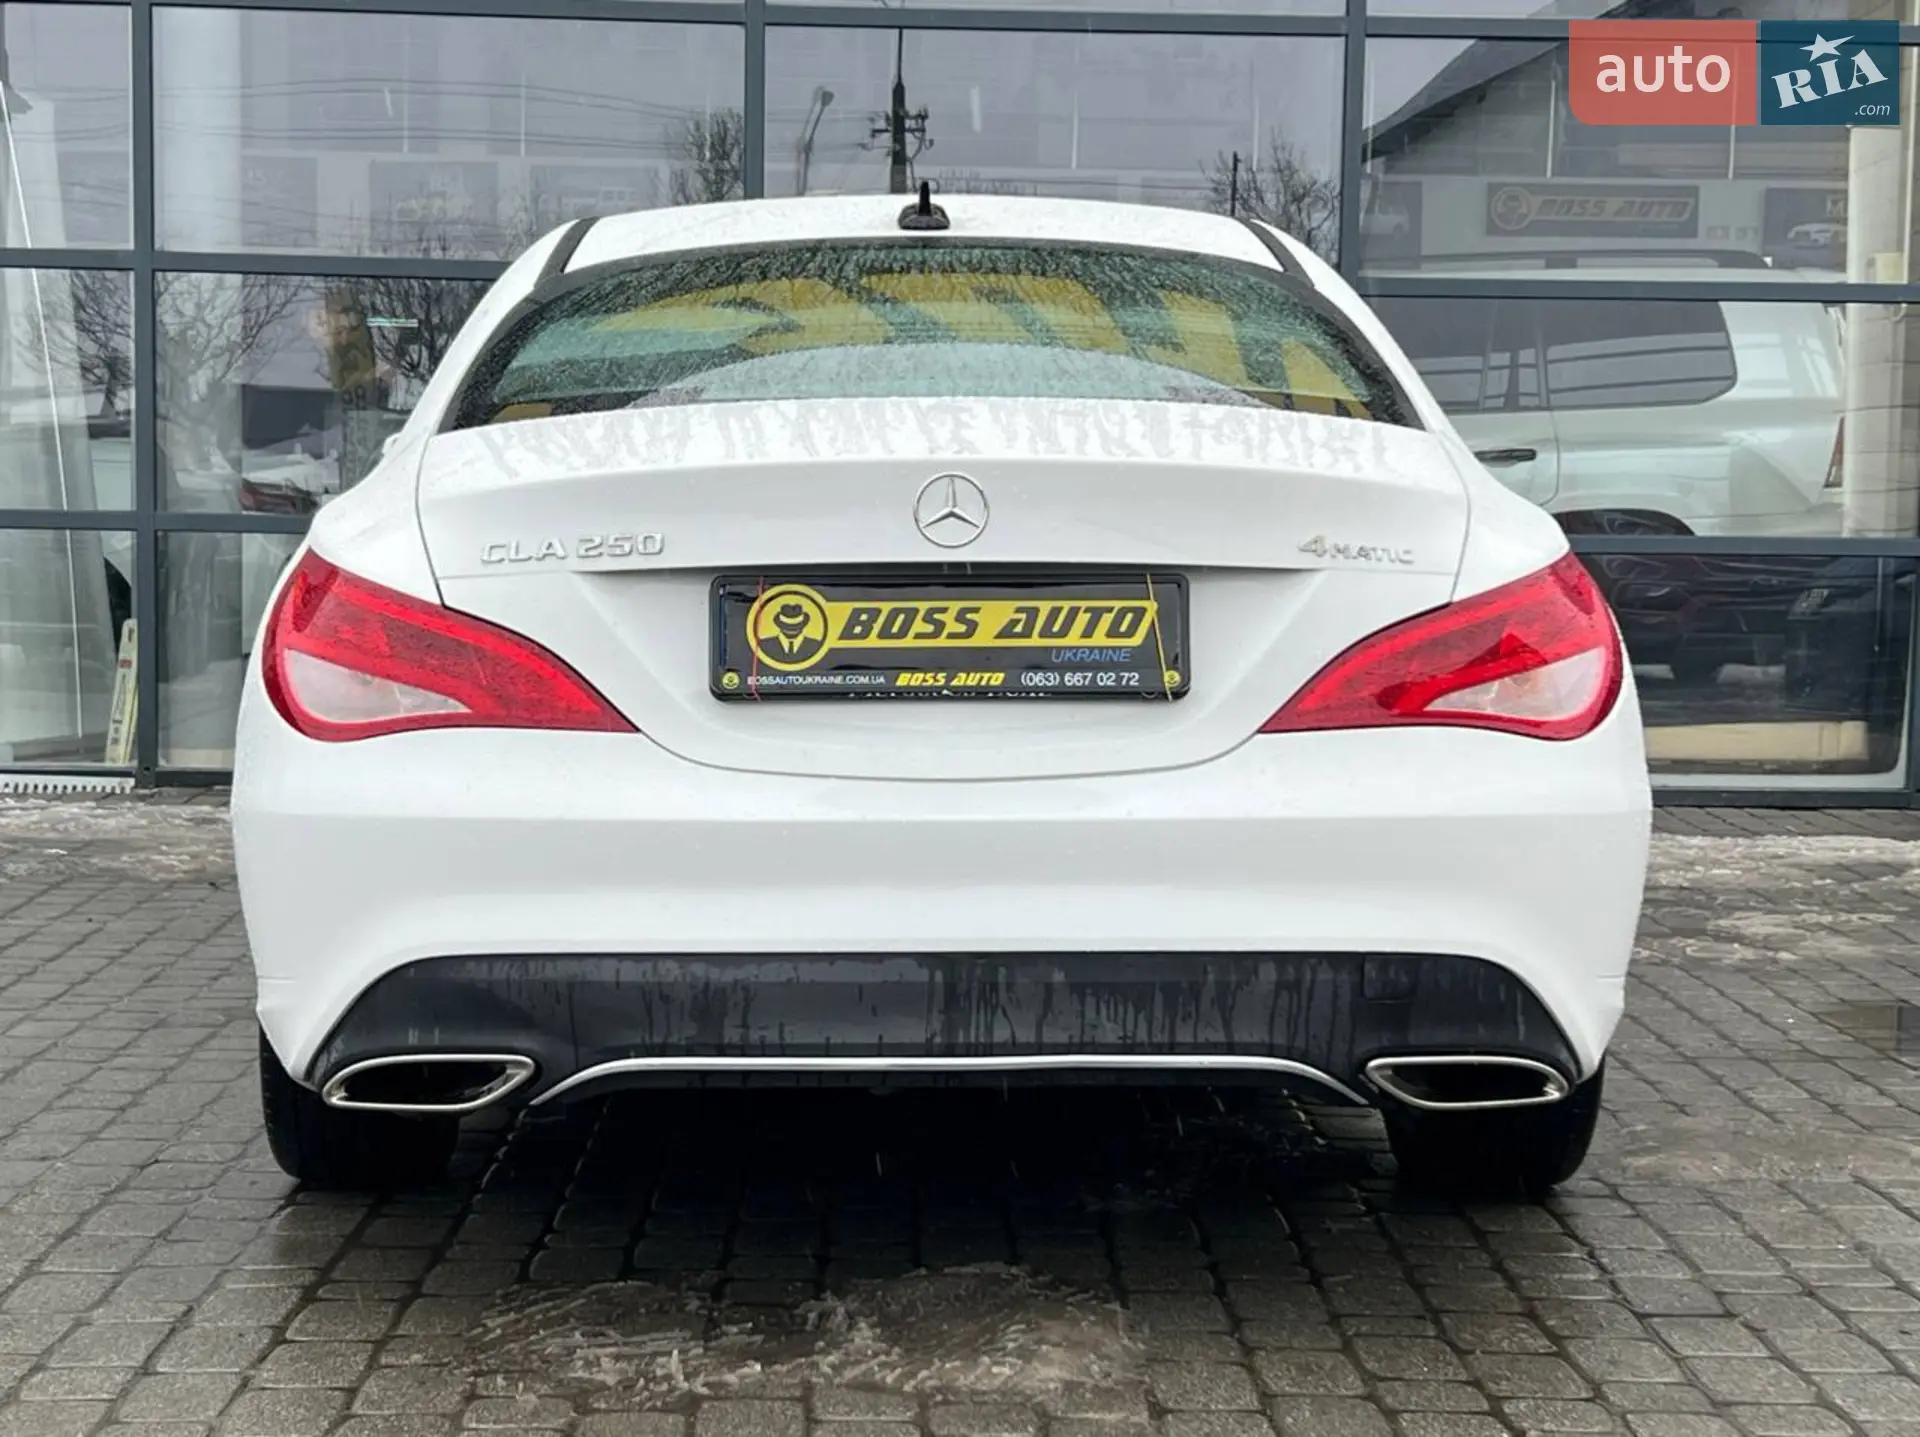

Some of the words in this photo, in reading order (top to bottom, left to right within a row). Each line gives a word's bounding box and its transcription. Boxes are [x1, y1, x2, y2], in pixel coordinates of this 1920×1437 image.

[480, 538, 568, 564] CLA
[576, 532, 665, 559] 250
[1297, 535, 1415, 565] 4MATIC
[837, 606, 982, 641] BOSS
[992, 605, 1148, 640] AUTO
[1051, 648, 1133, 663] UKRAINE
[747, 675, 886, 686] BOSSAUTOUKRAINE.COM.UA
[896, 672, 946, 687] BOSS
[950, 671, 1006, 686] AUTO
[1020, 672, 1060, 687] (063)
[1064, 672, 1091, 686] 667
[1097, 672, 1116, 686] 02
[1120, 672, 1140, 686] 72
